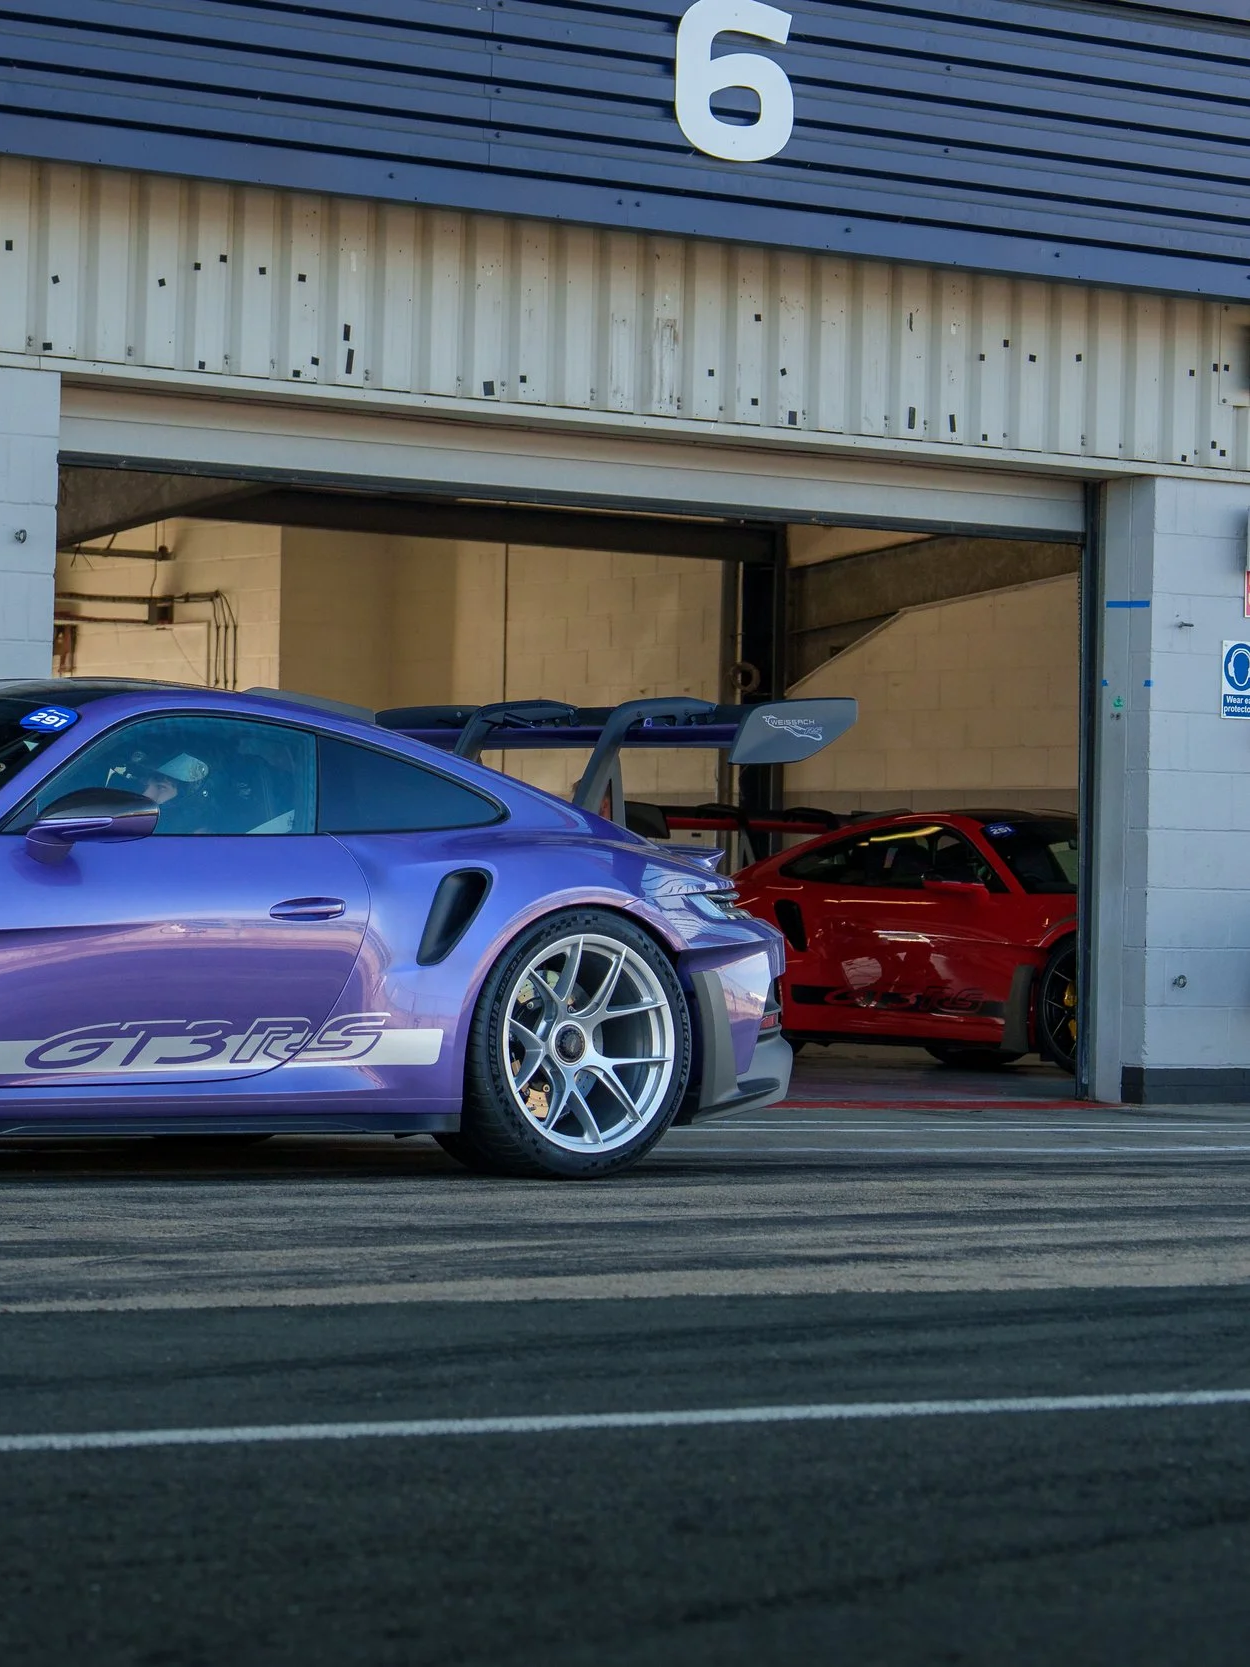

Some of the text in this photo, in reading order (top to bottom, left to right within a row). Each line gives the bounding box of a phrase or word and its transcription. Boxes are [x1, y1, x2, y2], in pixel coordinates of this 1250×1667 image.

[675, 0, 794, 162] 6
[29, 711, 68, 728] 291
[1226, 695, 1244, 704] Wear
[488, 1002, 500, 1076] MICHELIN
[681, 1011, 690, 1082] MICHELIN
